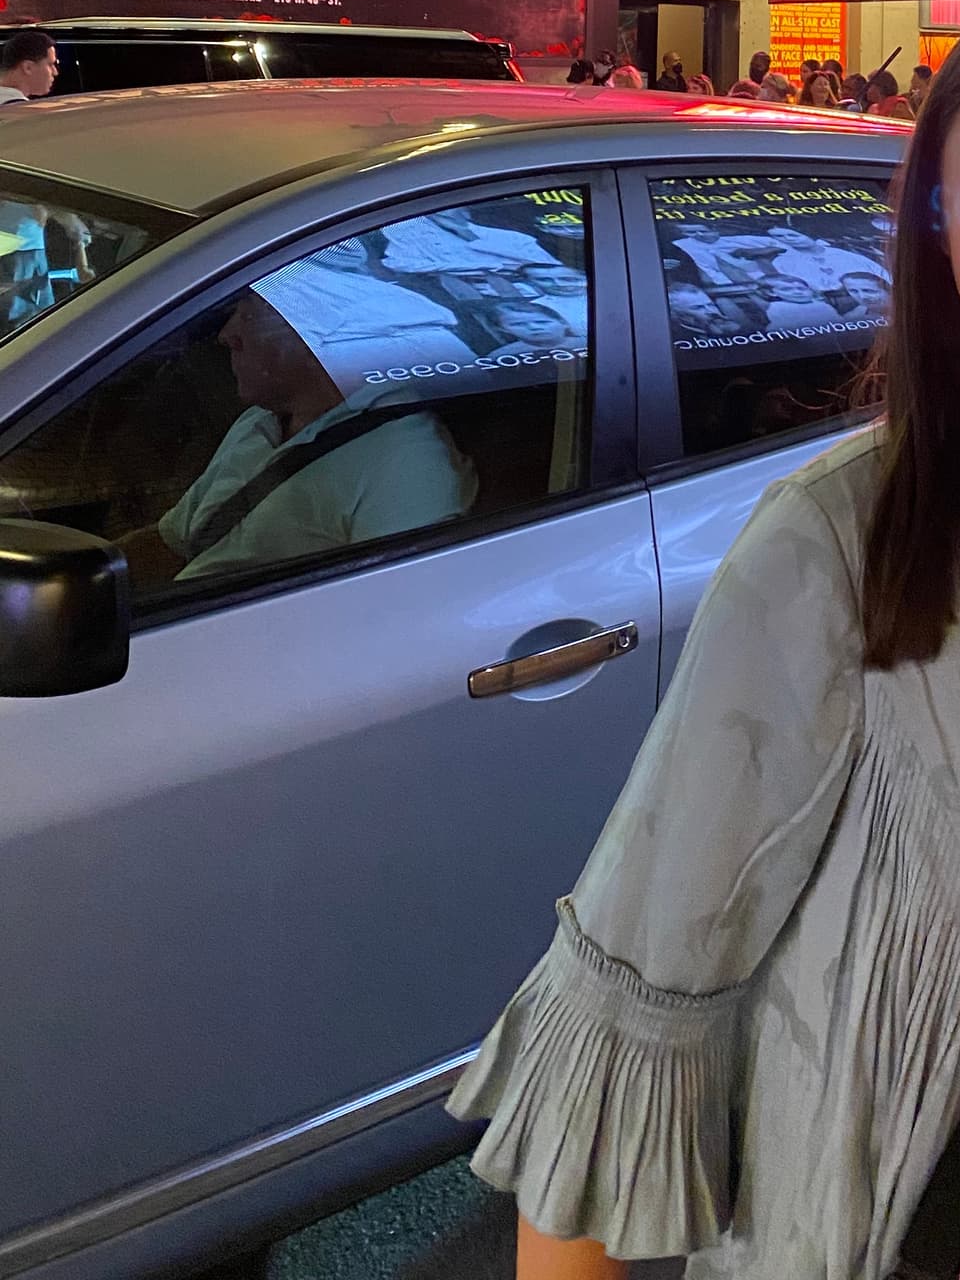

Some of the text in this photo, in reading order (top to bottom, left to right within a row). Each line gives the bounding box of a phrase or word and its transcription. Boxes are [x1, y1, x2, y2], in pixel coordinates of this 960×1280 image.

[782, 16, 818, 28] ALL-STAR
[820, 18, 840, 29] CAST
[782, 51, 800, 61] FACE
[804, 52, 823, 61] WAS
